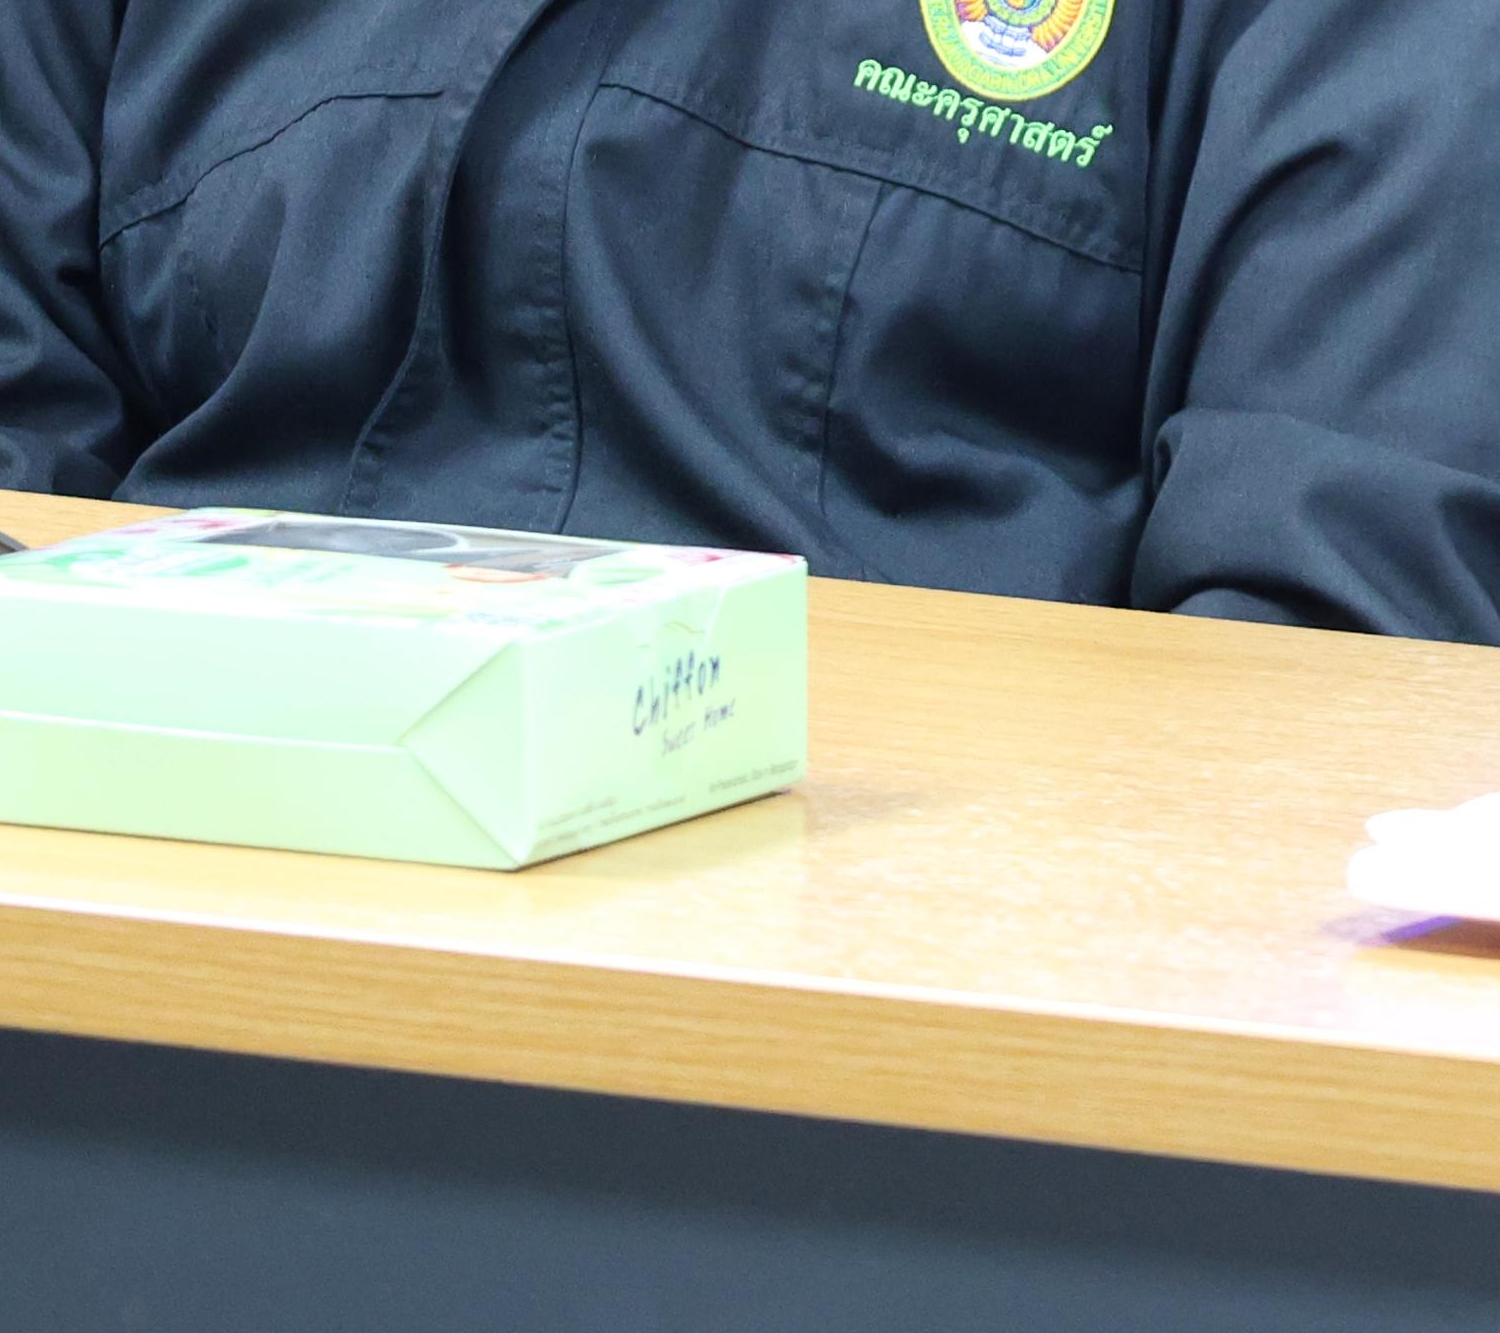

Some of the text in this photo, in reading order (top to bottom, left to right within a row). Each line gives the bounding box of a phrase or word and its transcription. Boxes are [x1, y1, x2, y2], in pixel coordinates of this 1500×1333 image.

[852, 57, 1113, 169] คณะครุศาสตร์
[631, 647, 723, 736] Chiffon
[701, 697, 737, 733] Home
